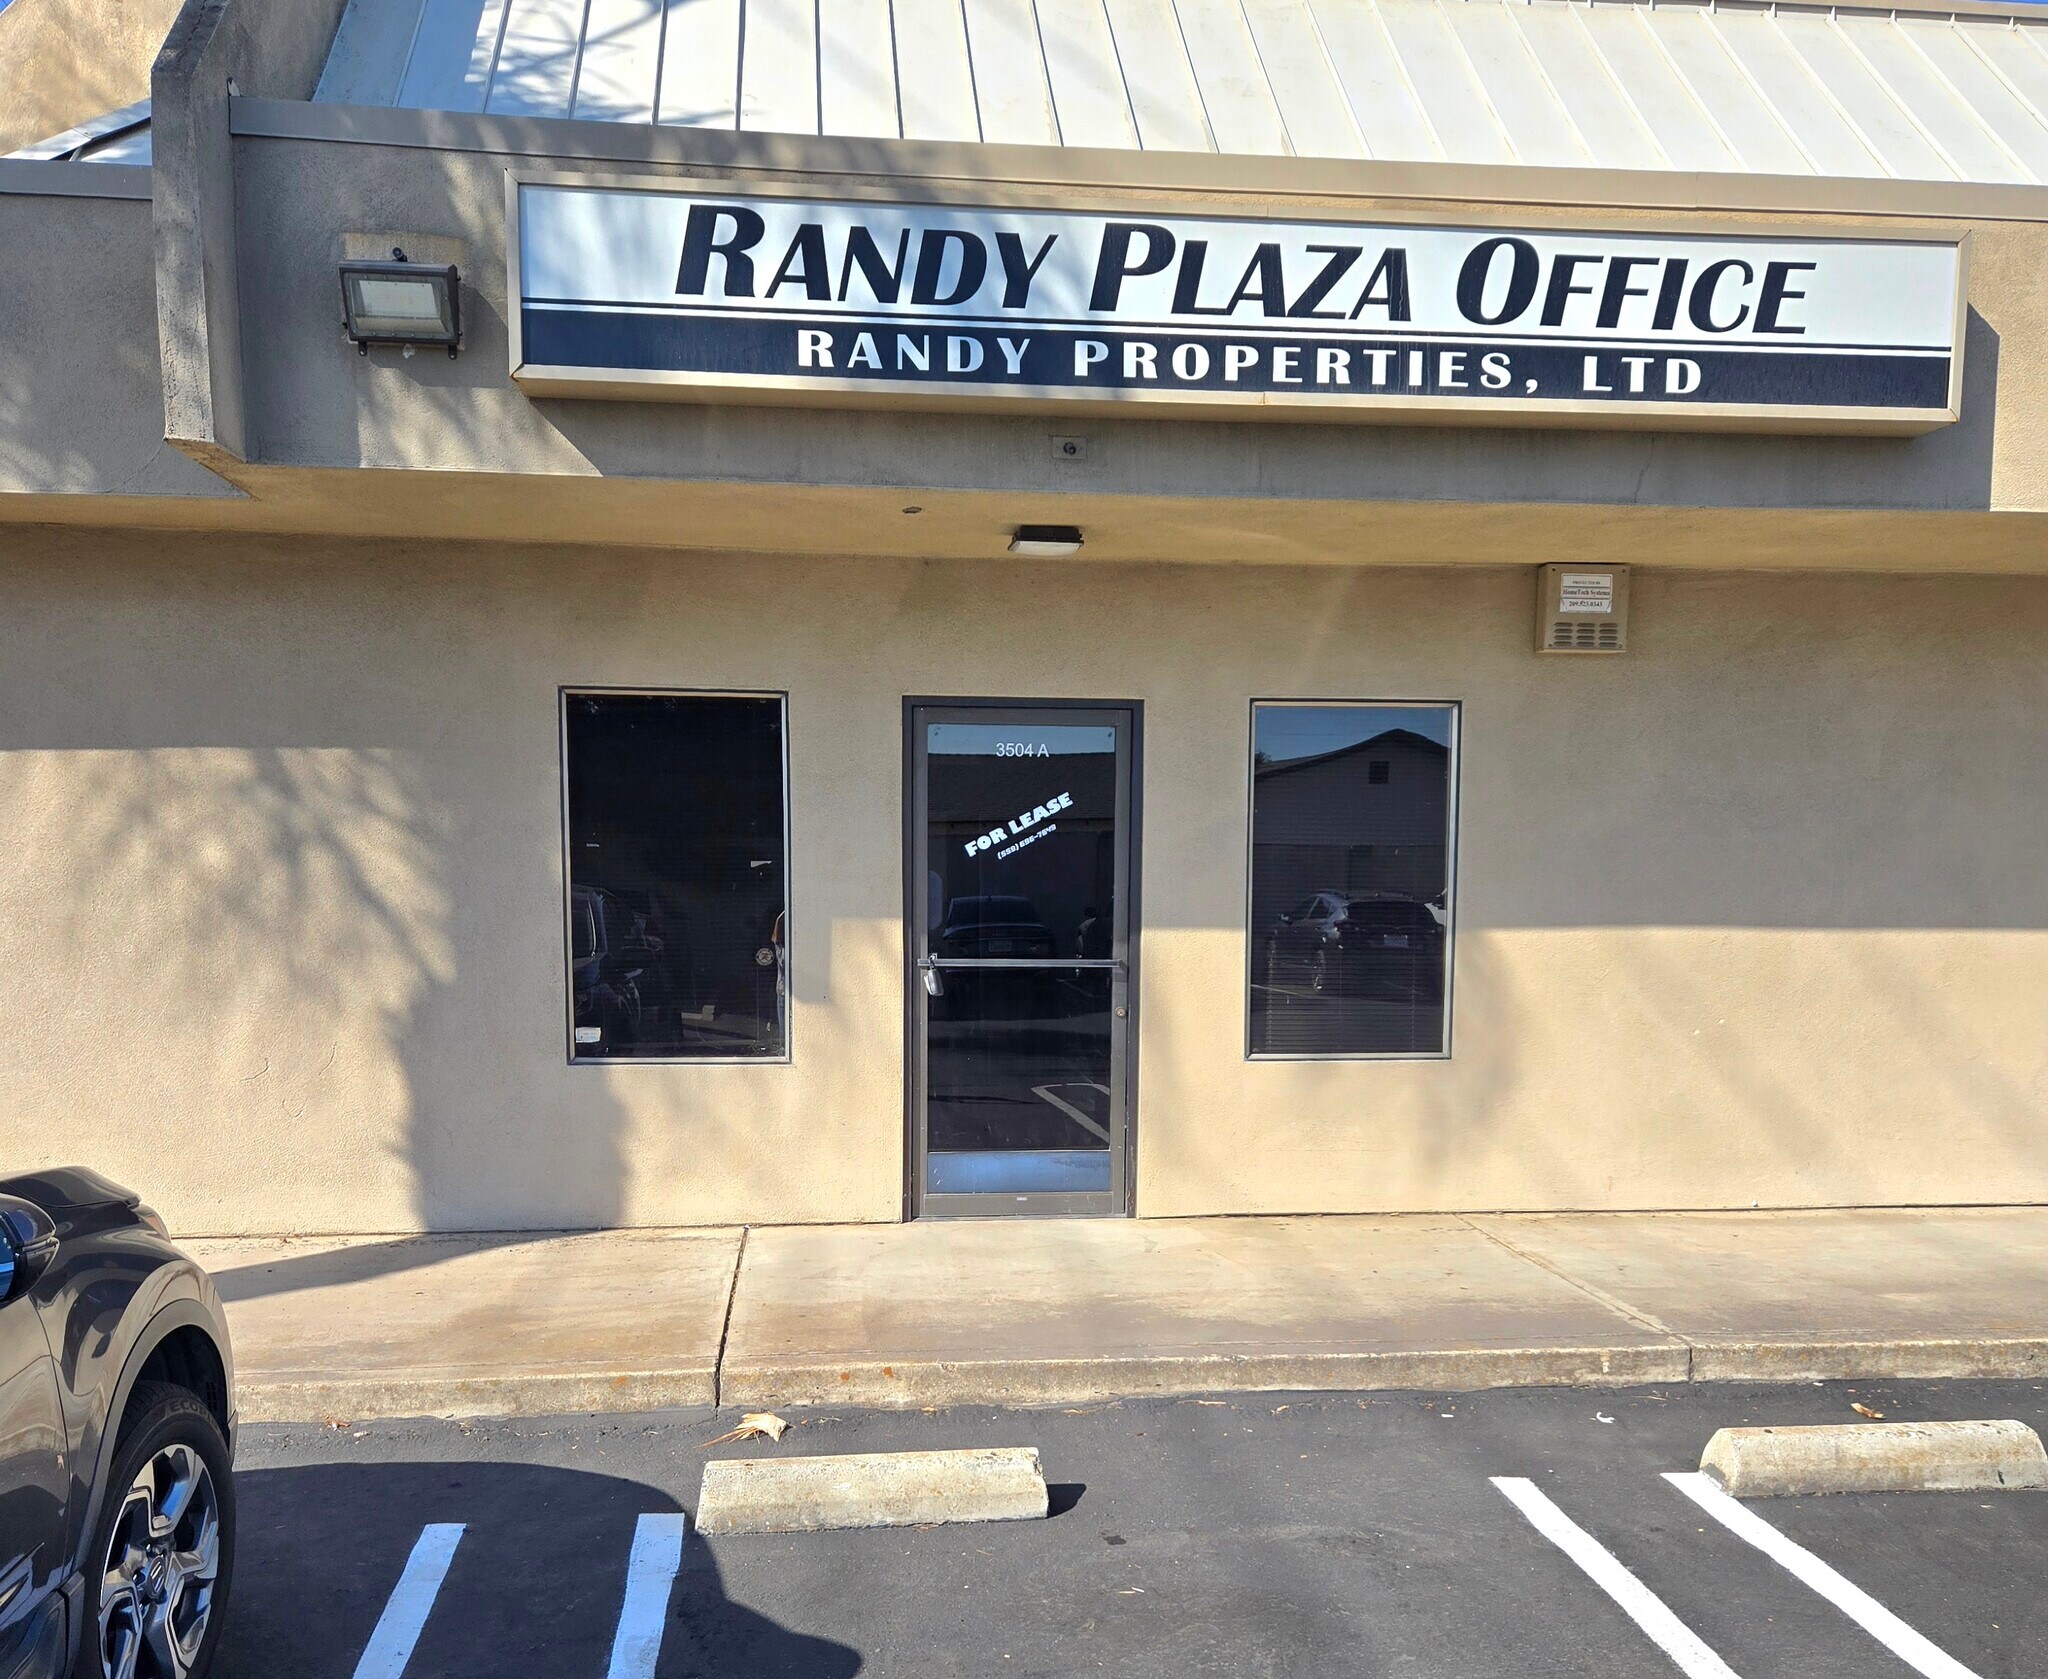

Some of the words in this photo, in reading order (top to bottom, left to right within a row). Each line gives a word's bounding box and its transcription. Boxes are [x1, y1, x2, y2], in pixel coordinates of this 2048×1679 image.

[675, 204, 1058, 309] RANDY
[1088, 222, 1412, 322] PLAZA
[1456, 233, 1817, 335] OFFICE
[797, 329, 1031, 374] RANDY
[1074, 340, 1538, 394] PROPERTIES,
[1582, 355, 1702, 394] LTD
[1590, 589, 1610, 597] Systems
[996, 742, 1034, 757] 3504
[1037, 743, 1050, 758] A
[964, 827, 1008, 858] FOR
[1008, 791, 1074, 835] LEASE
